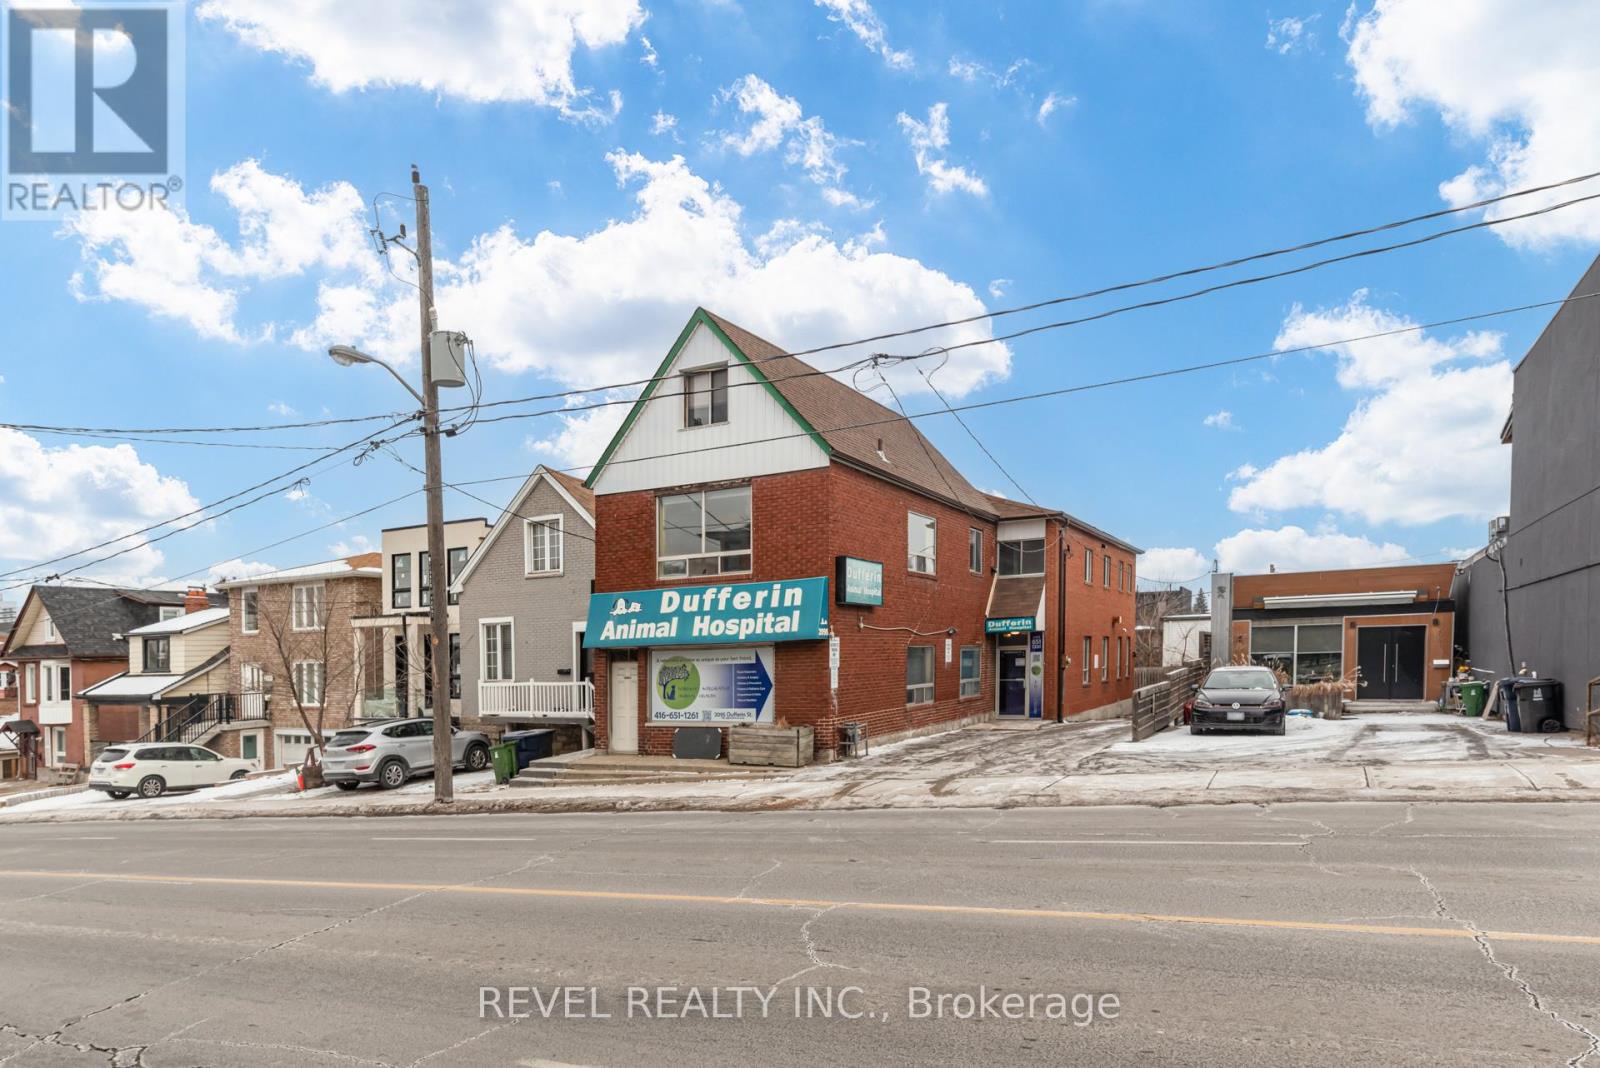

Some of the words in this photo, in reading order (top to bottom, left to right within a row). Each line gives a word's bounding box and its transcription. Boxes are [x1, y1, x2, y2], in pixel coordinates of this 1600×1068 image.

[847, 565, 882, 583] Dufferin
[659, 584, 803, 614] Dufferin
[600, 617, 679, 641] Animal
[692, 610, 801, 640] Hospital
[988, 618, 1032, 628] Dufferin
[654, 711, 699, 720] 416-651-1261
